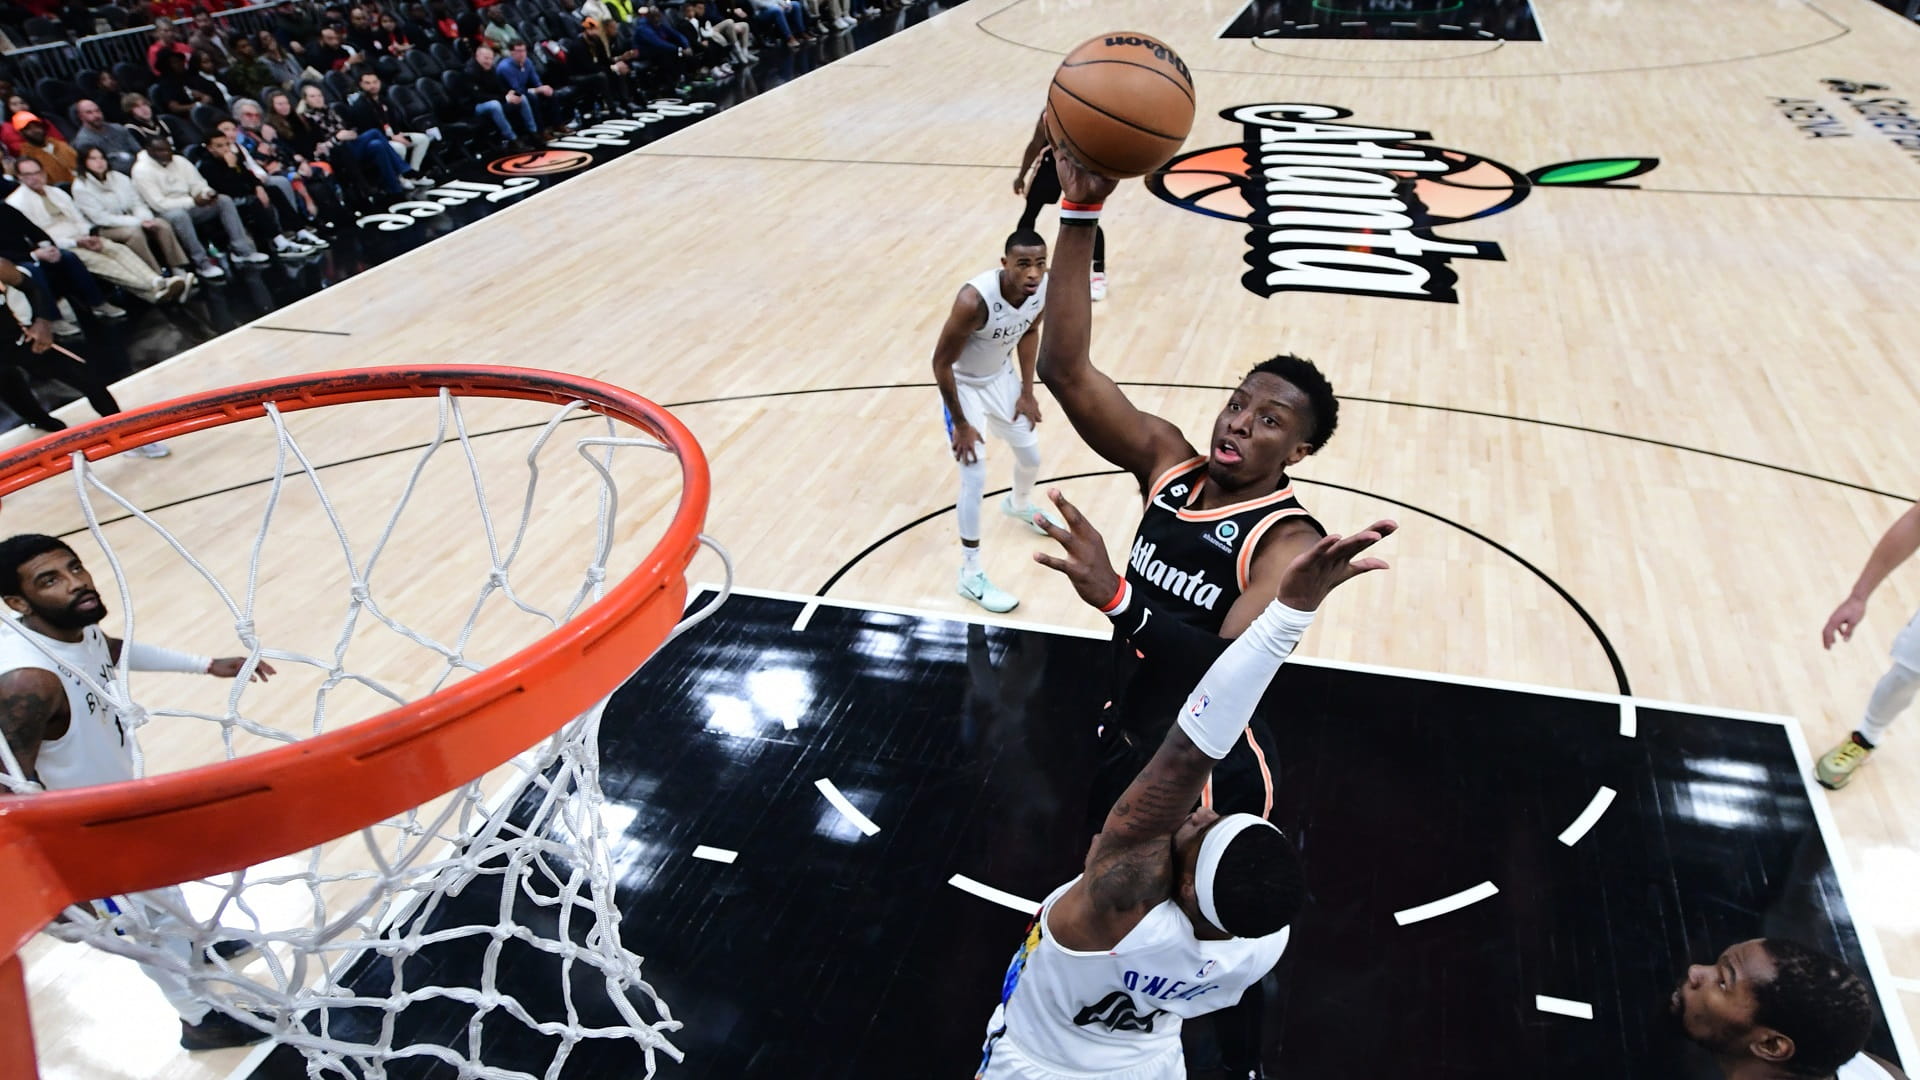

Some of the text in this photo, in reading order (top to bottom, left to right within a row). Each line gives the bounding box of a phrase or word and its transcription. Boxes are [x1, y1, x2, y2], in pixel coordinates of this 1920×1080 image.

[1233, 103, 1480, 295] Atlanta
[1170, 483, 1189, 498] 6
[1130, 534, 1224, 611] Atlanta
